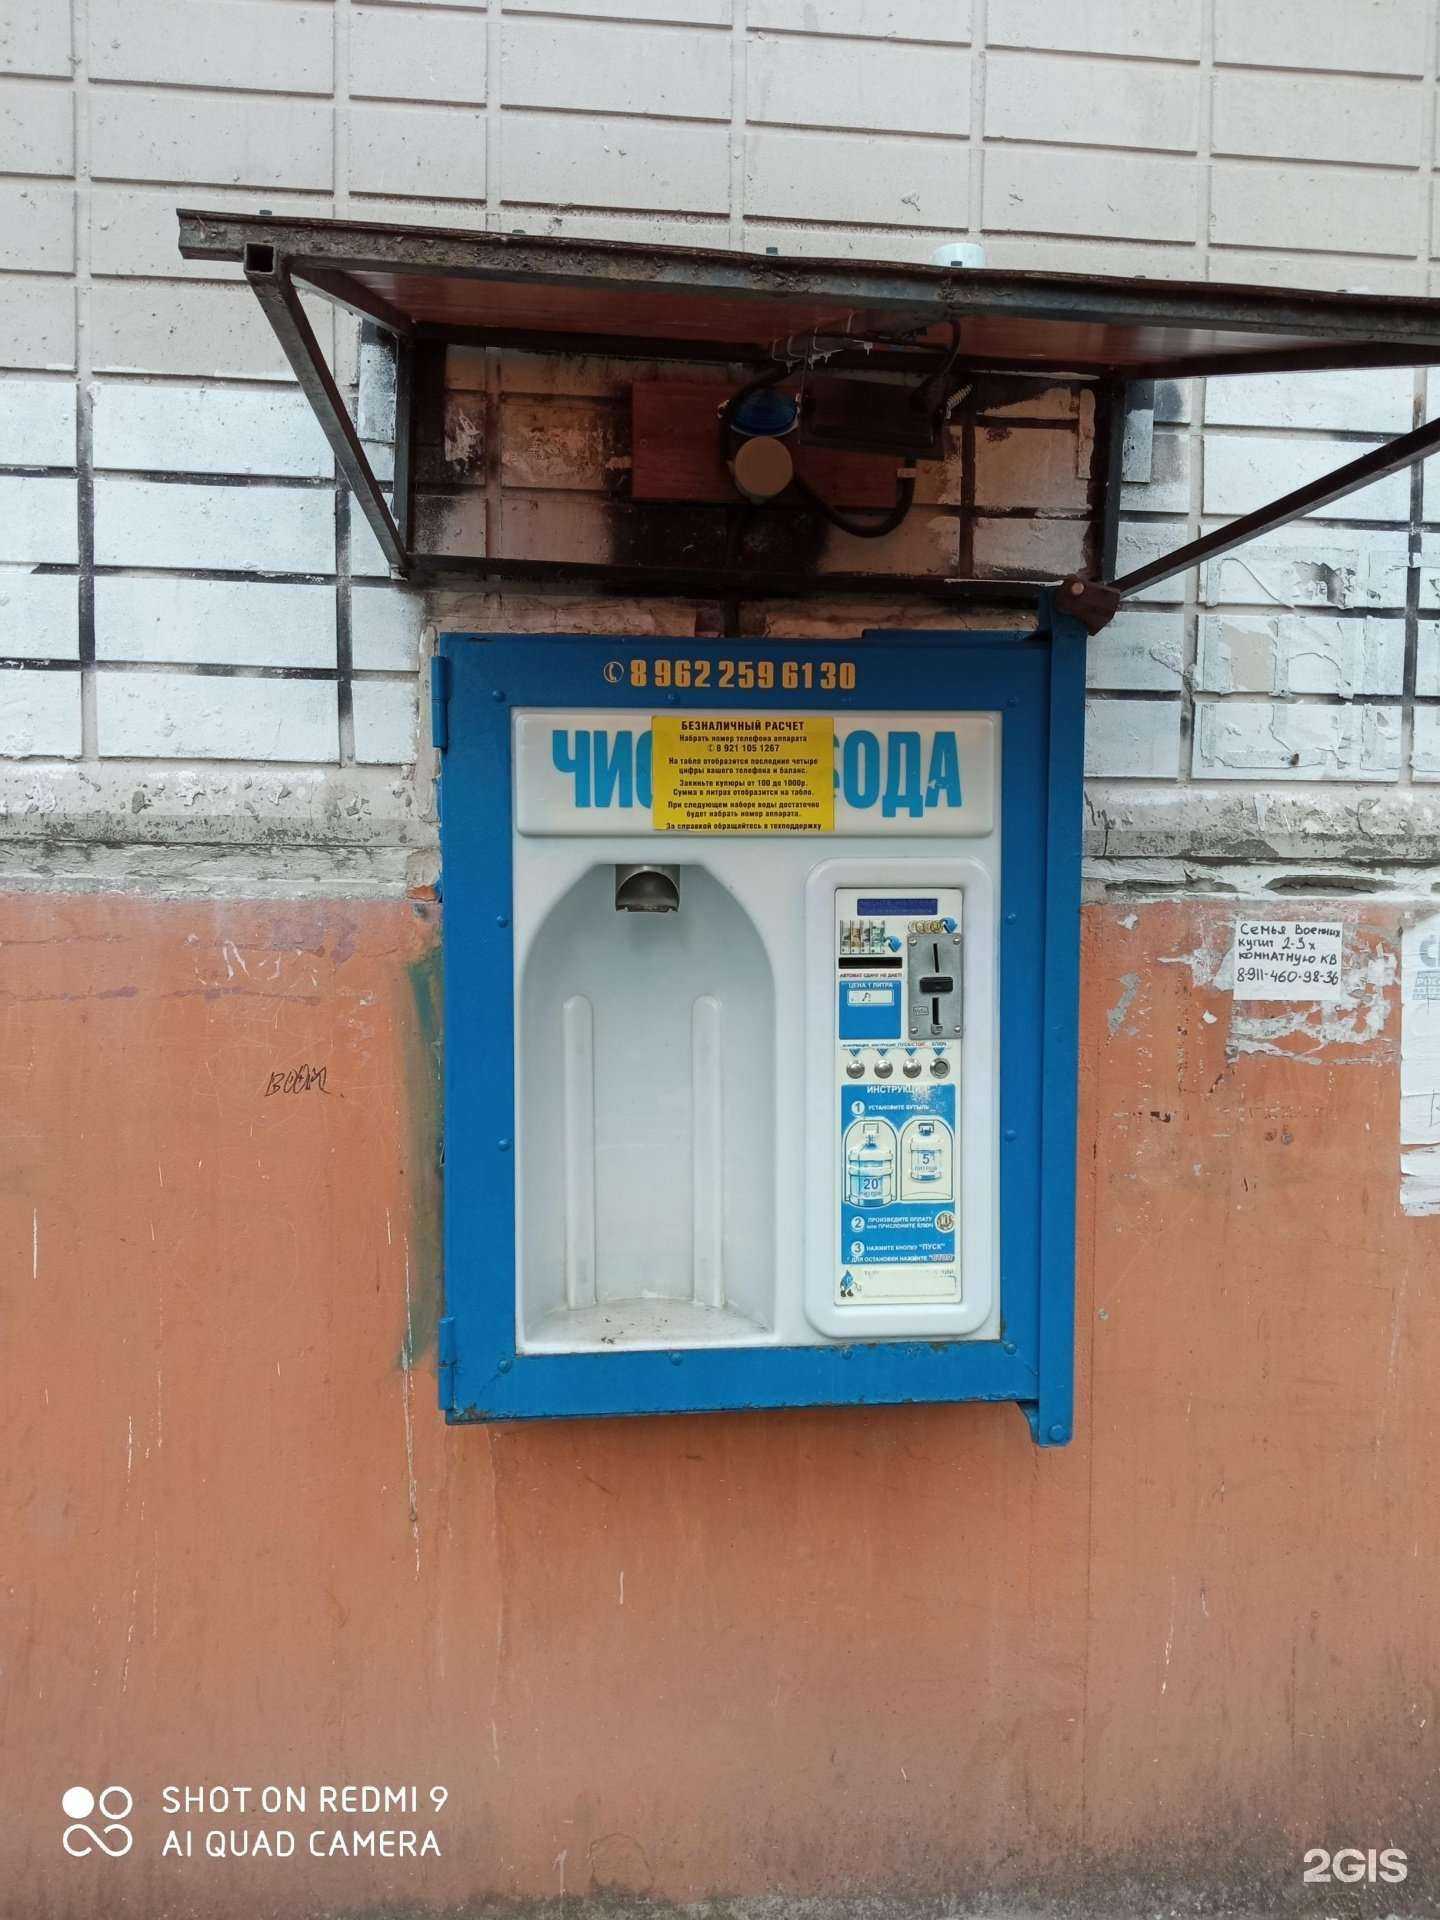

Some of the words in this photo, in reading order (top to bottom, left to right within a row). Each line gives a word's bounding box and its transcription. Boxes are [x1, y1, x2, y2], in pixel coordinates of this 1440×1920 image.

[630, 659, 647, 687] 8
[654, 659, 711, 688] 962
[718, 660, 775, 689] 259
[681, 720, 761, 731] БЕЗНАЛИЧНЫЙ
[765, 720, 805, 731] РАСЧЕТ
[680, 734, 709, 742] Набрать
[712, 734, 734, 742] номер
[736, 734, 771, 742] телефона
[774, 734, 807, 742] аппарата
[724, 744, 739, 752] 921
[742, 744, 757, 752] 105
[679, 767, 704, 775] цифры
[736, 767, 770, 775] телефона
[833, 729, 962, 818] ОДА
[668, 801, 681, 809] При
[684, 801, 728, 809] следующем
[863, 1178, 879, 1190] 20
